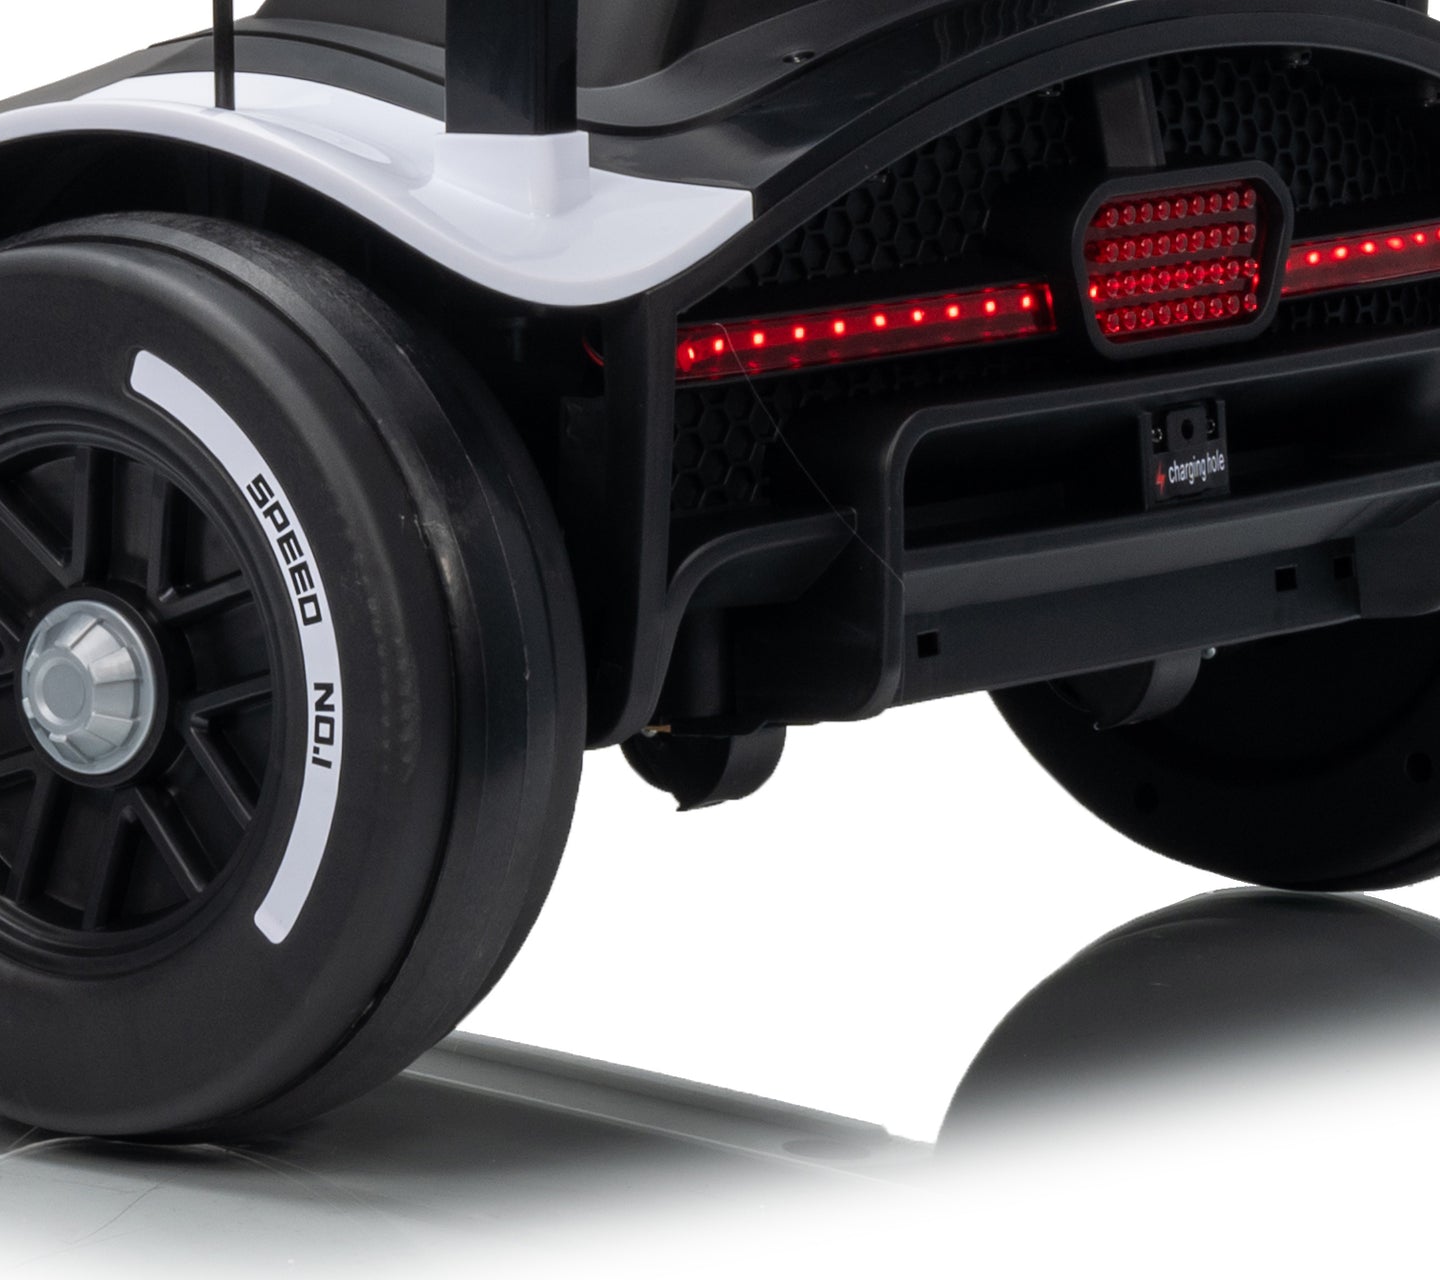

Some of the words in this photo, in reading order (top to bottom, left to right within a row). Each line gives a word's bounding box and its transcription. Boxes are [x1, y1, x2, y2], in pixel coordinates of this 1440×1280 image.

[1168, 454, 1207, 485] charging
[1206, 448, 1225, 475] hole
[246, 474, 322, 627] SPEED
[312, 682, 335, 770] NO.1
